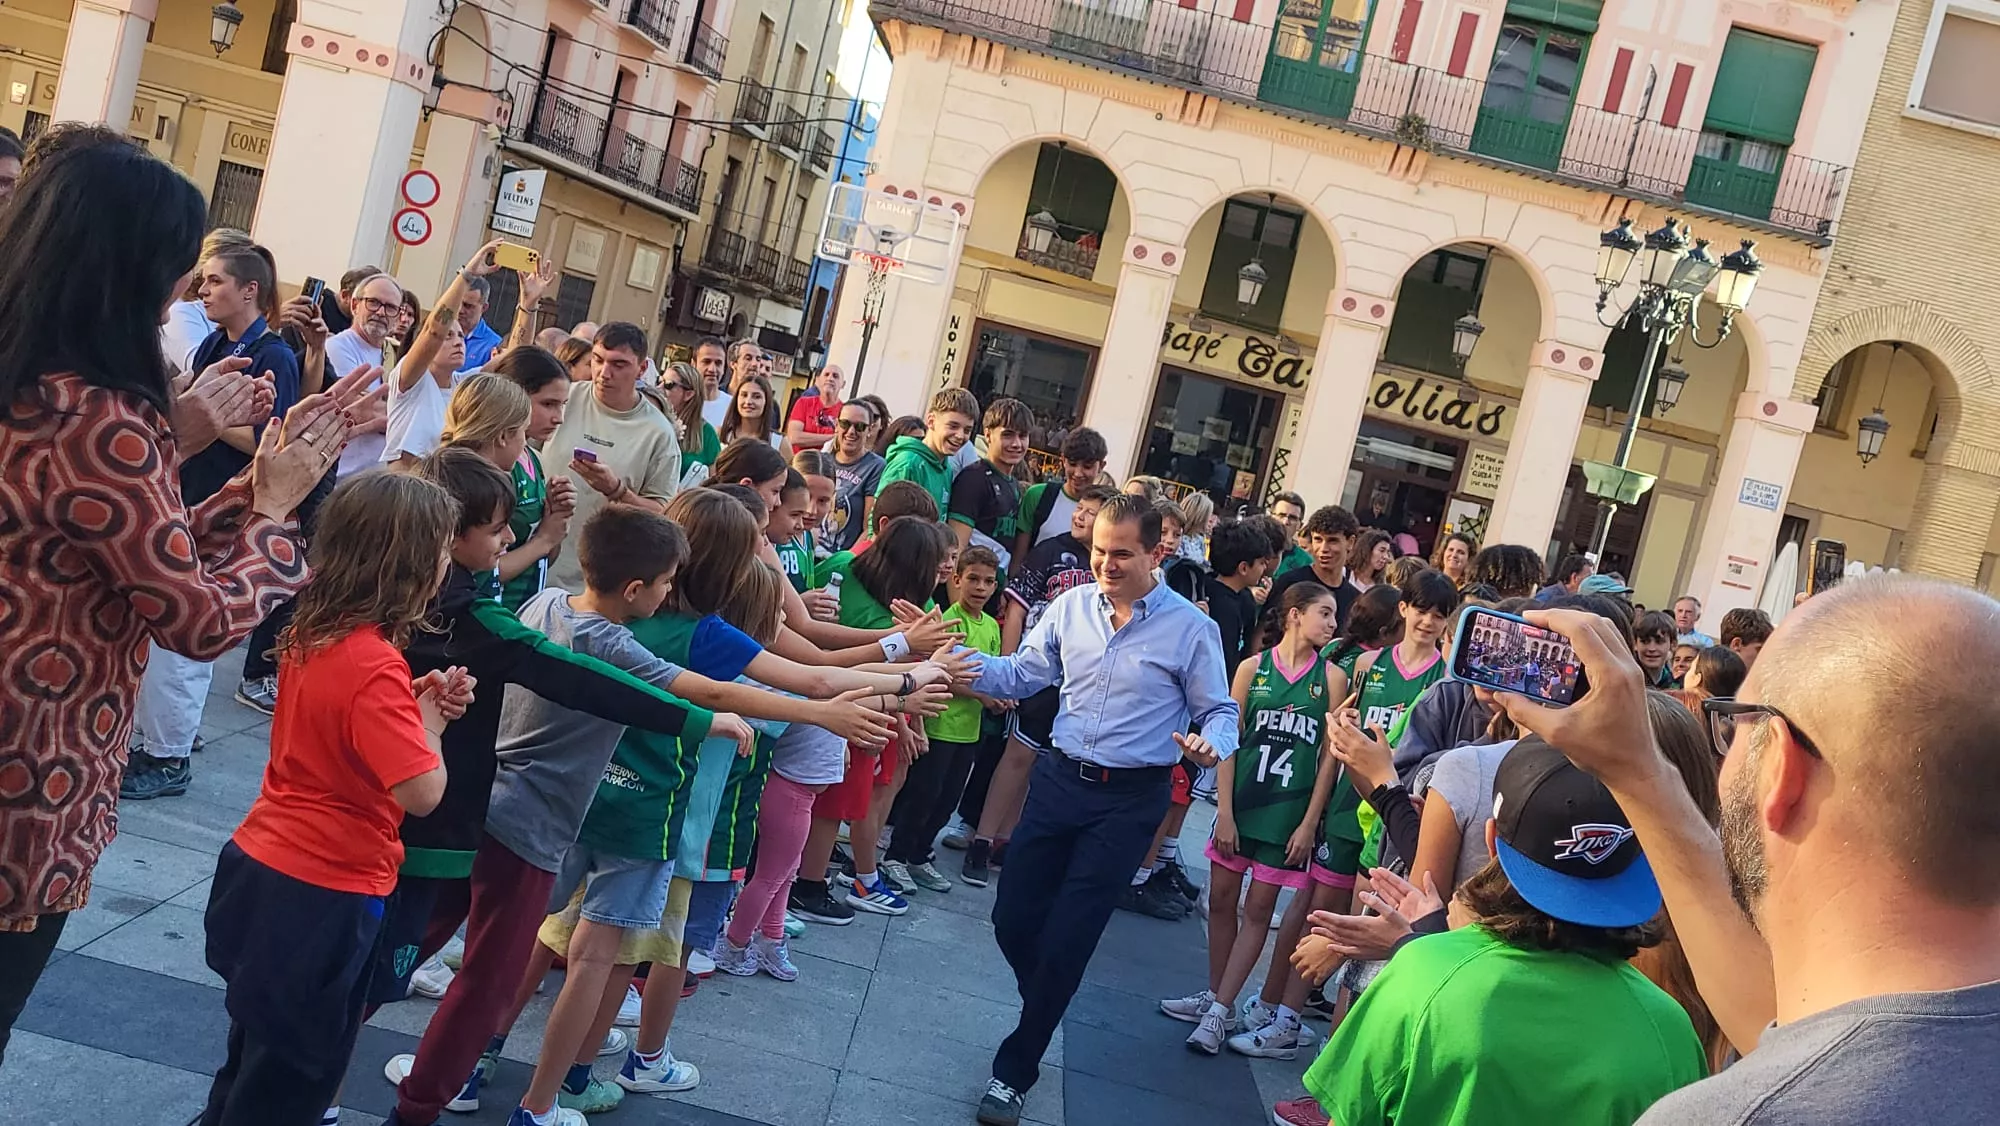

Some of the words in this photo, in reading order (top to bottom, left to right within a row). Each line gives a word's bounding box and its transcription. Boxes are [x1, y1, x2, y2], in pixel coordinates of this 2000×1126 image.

[503, 191, 534, 206] VELTINS
[875, 200, 915, 216] TARMAK
[1256, 744, 1294, 787] 14
[1572, 833, 1614, 853] OKC
